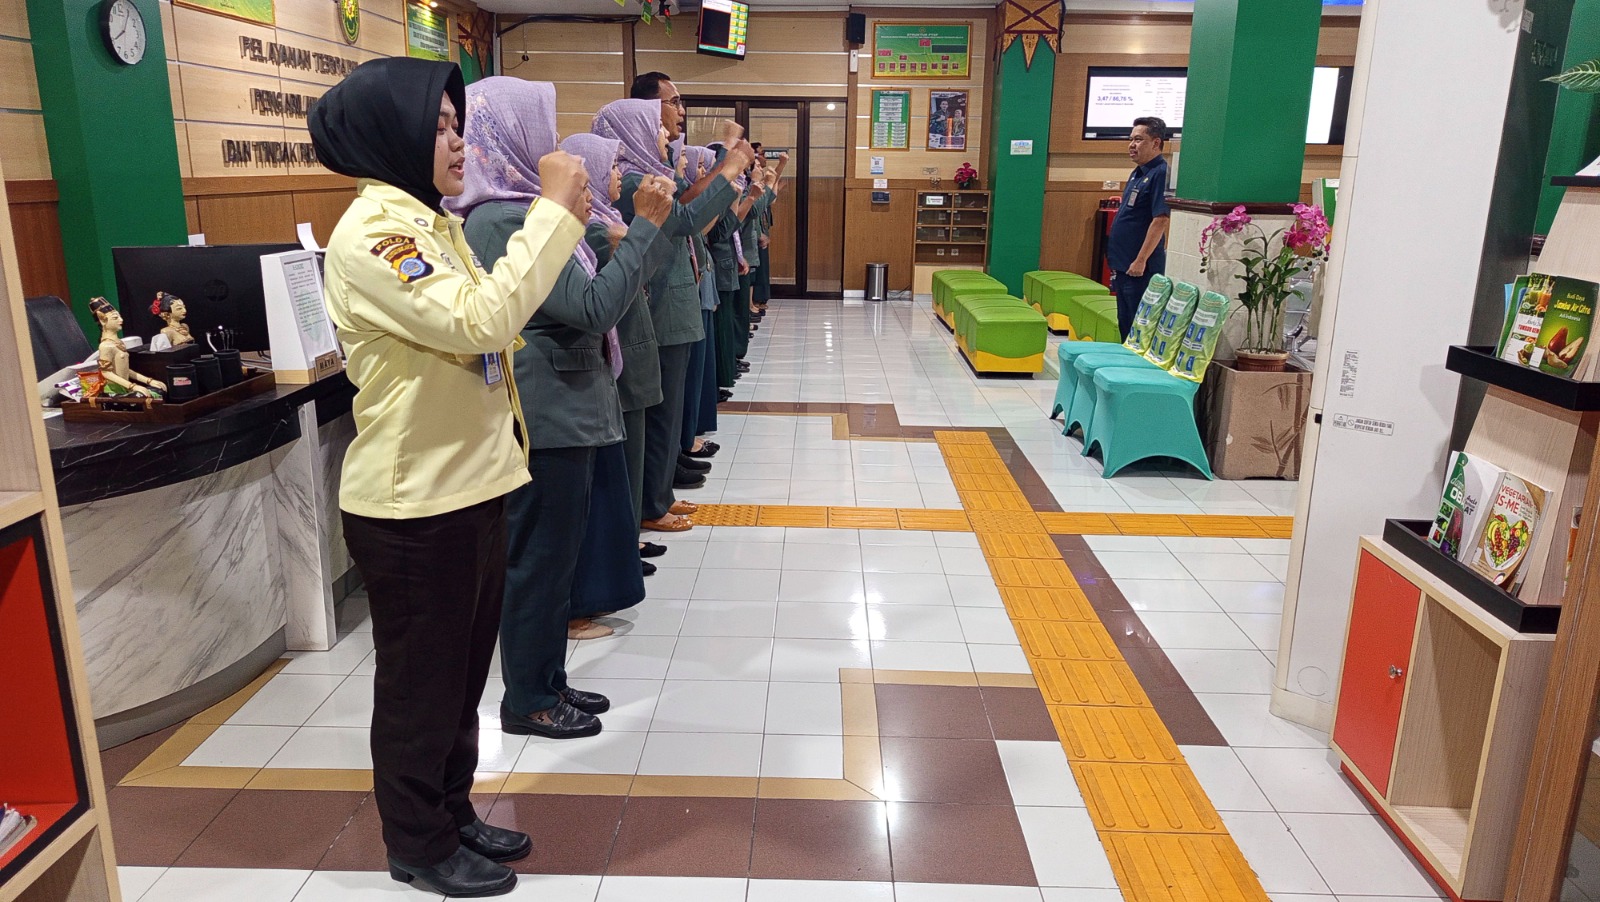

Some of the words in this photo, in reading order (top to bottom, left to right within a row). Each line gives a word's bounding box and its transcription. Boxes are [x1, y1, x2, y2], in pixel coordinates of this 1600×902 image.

[239, 36, 312, 71] PELAYANAN
[222, 139, 252, 168] DAN
[252, 141, 298, 168] TINDAK
[375, 237, 410, 252] POLDA
[1571, 303, 1579, 312] Air
[319, 358, 335, 370] MAYA
[1496, 494, 1520, 515] IS-ME
